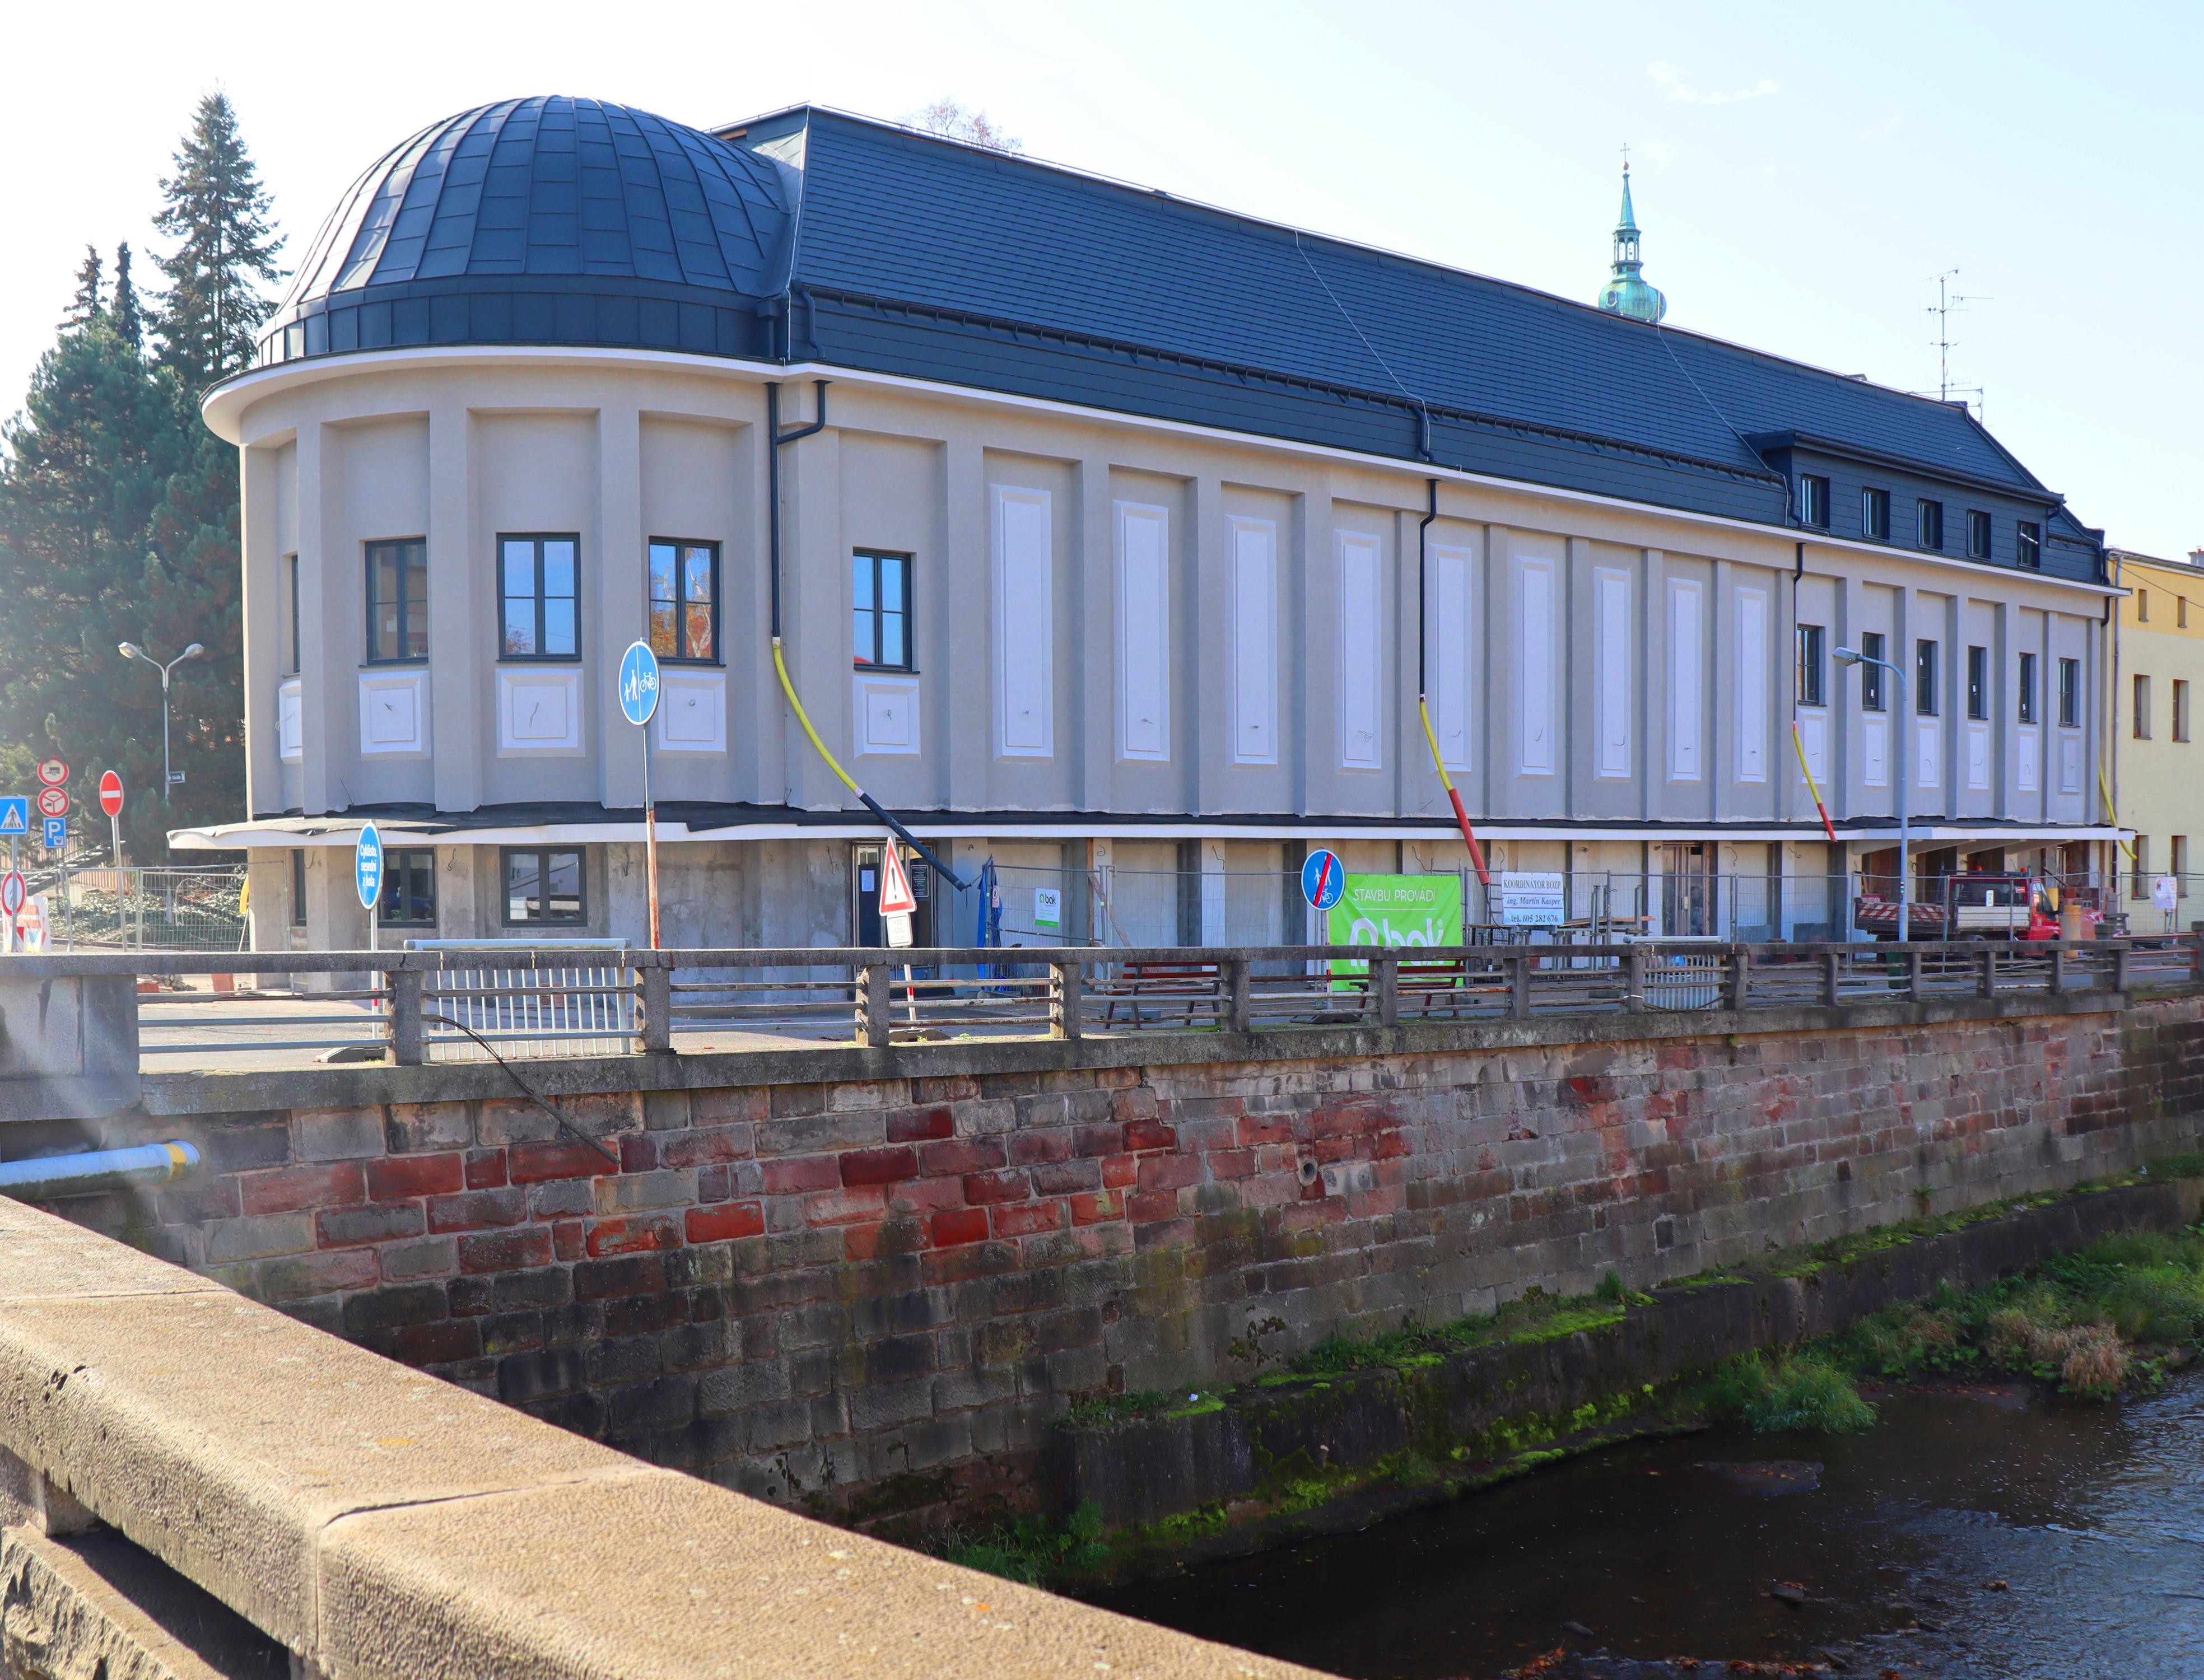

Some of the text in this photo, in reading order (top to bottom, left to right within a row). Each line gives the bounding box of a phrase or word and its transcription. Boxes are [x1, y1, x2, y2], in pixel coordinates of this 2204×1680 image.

[49, 822, 61, 838] P
[360, 844, 378, 859] Cyklisto,
[360, 860, 377, 872] sesedni
[362, 874, 375, 888] z kola
[1503, 878, 1561, 889] KOORDINÁTOR BOZP
[1045, 894, 1056, 905] bak
[1353, 887, 1437, 902] STAVBU PROVÁDÍ
[1507, 897, 1518, 906] ing.
[1541, 897, 1561, 906] Kasper
